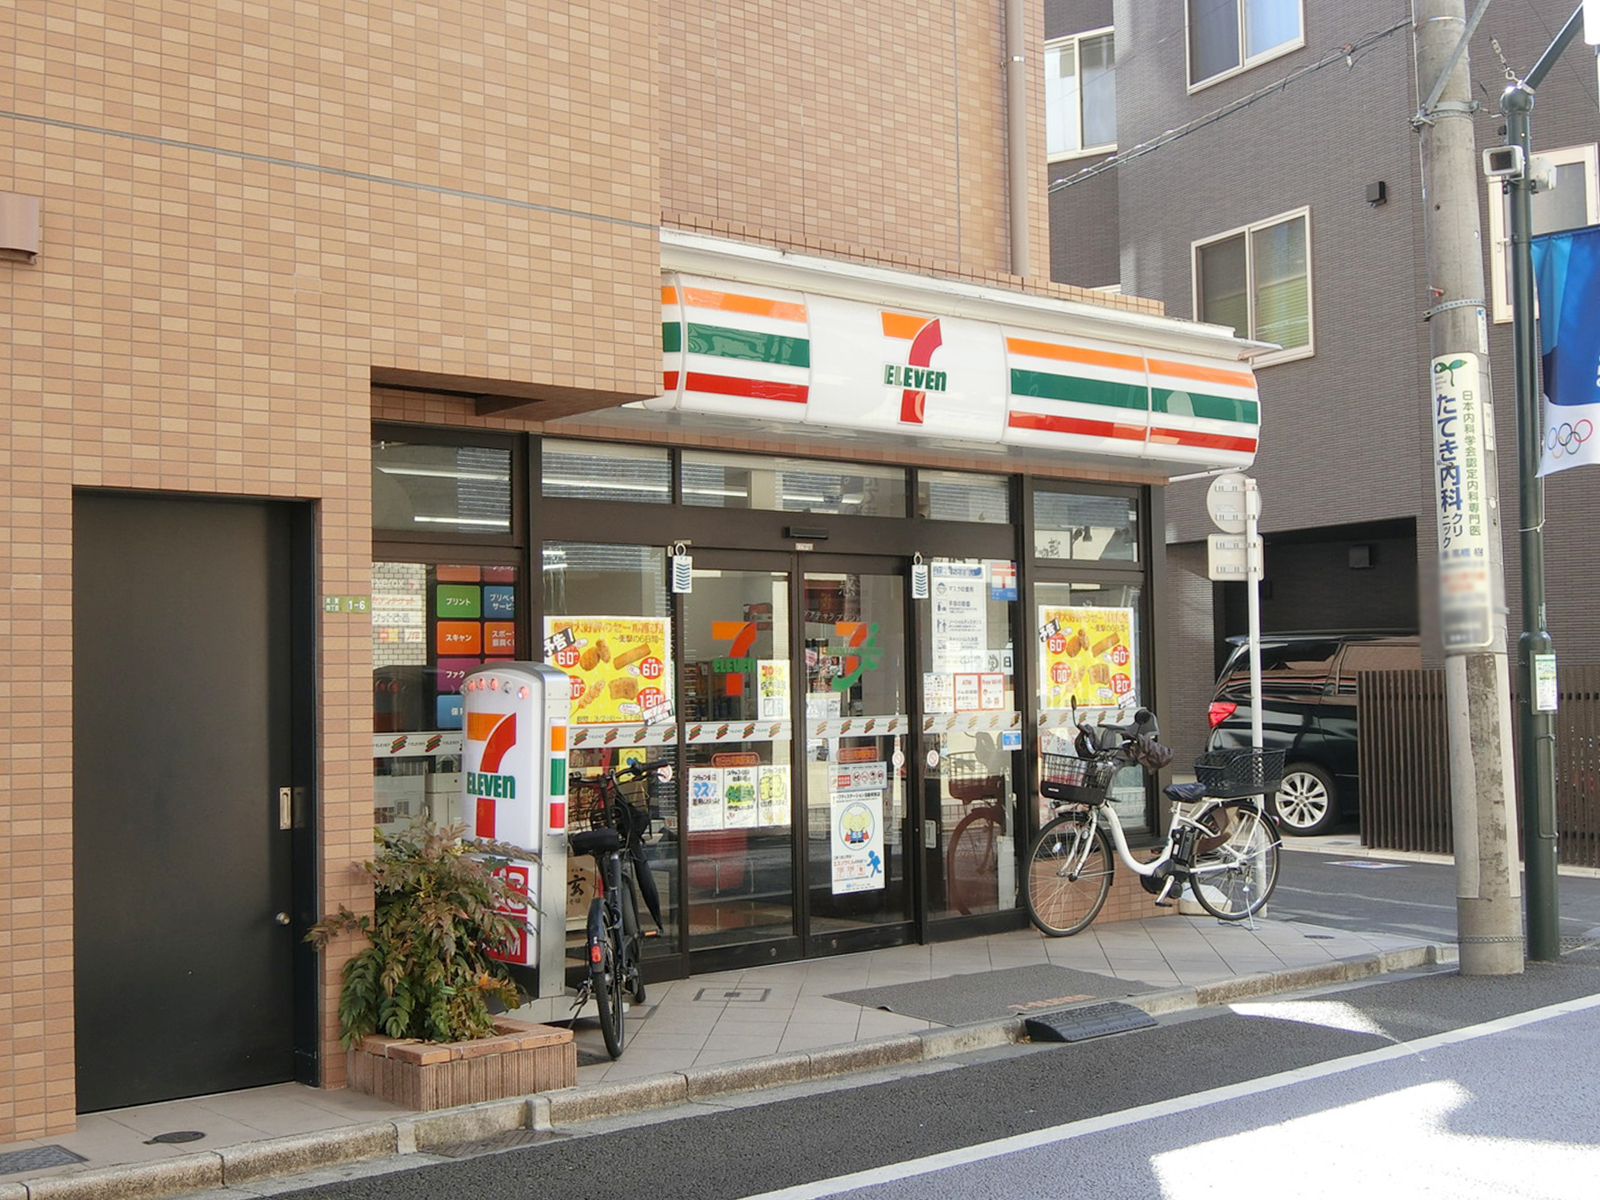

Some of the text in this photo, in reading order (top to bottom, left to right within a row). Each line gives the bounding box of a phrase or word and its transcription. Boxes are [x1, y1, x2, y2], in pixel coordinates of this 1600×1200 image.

[1461, 390, 1482, 537] 日本内科学会認定内科専門医
[348, 600, 366, 610] 1-6
[445, 597, 472, 606] プリント
[445, 633, 473, 642] スキャン
[492, 630, 514, 638] スポー
[445, 670, 466, 679] ファク
[693, 783, 718, 798] マスク
